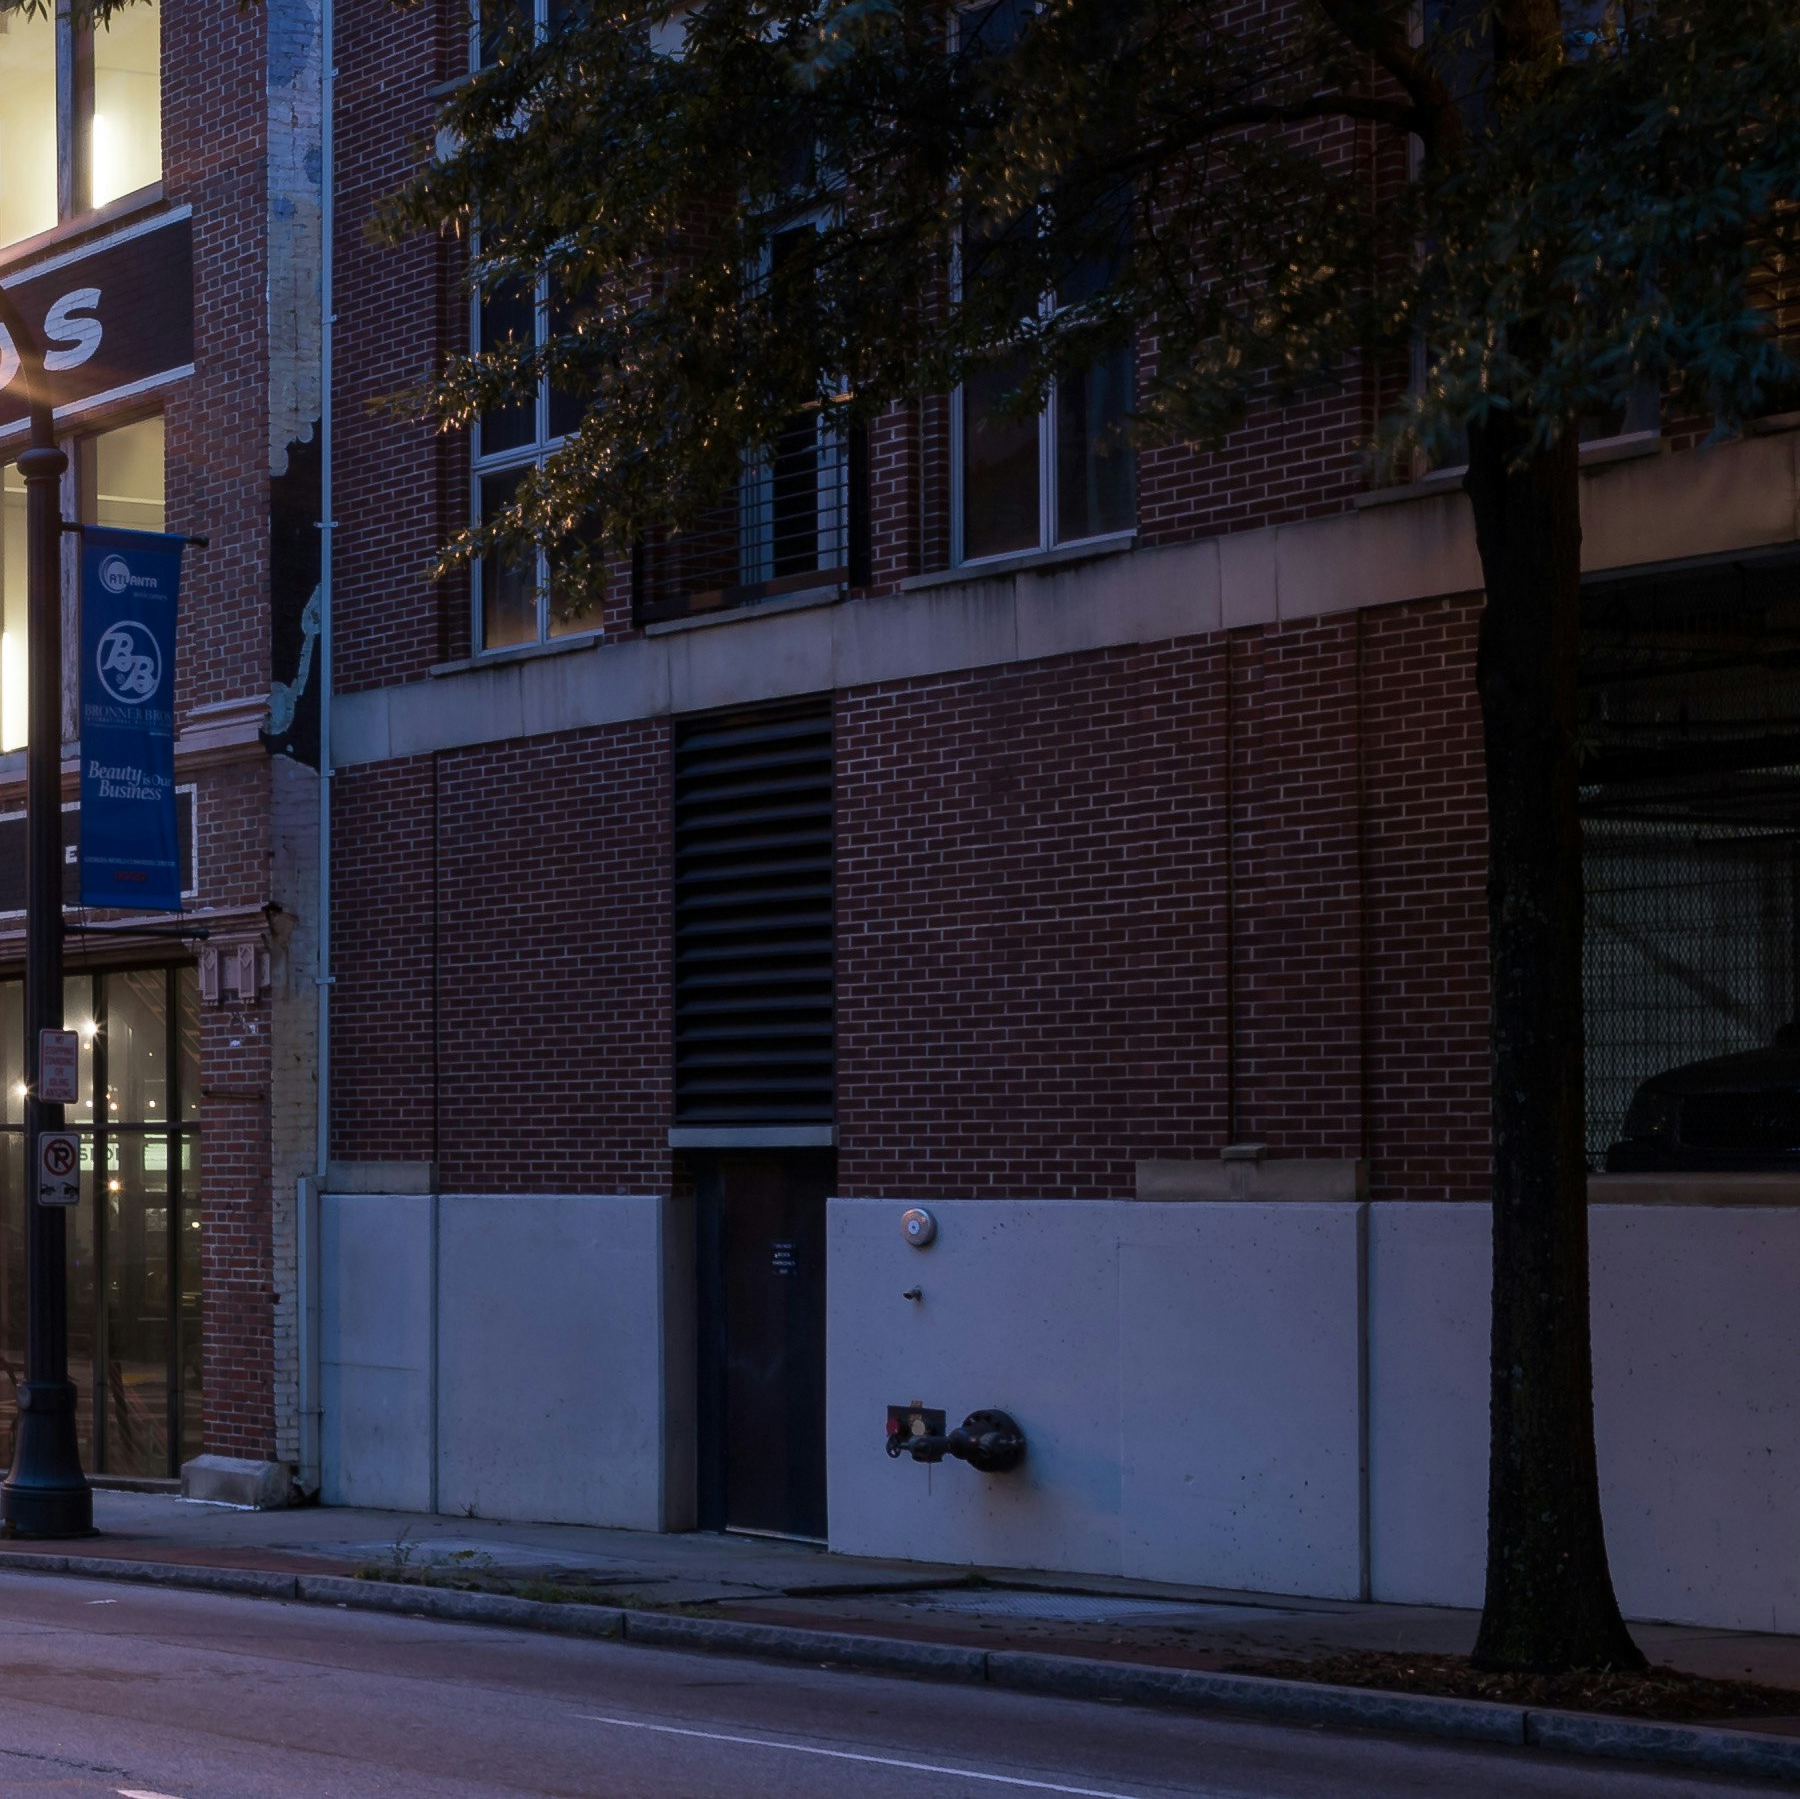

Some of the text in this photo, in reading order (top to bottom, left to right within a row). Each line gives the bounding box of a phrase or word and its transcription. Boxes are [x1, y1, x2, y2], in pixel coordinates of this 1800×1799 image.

[109, 573, 158, 588] ATLANTA
[84, 704, 142, 720] BRONNER
[88, 760, 142, 787] Beauty
[99, 779, 162, 801] Business
